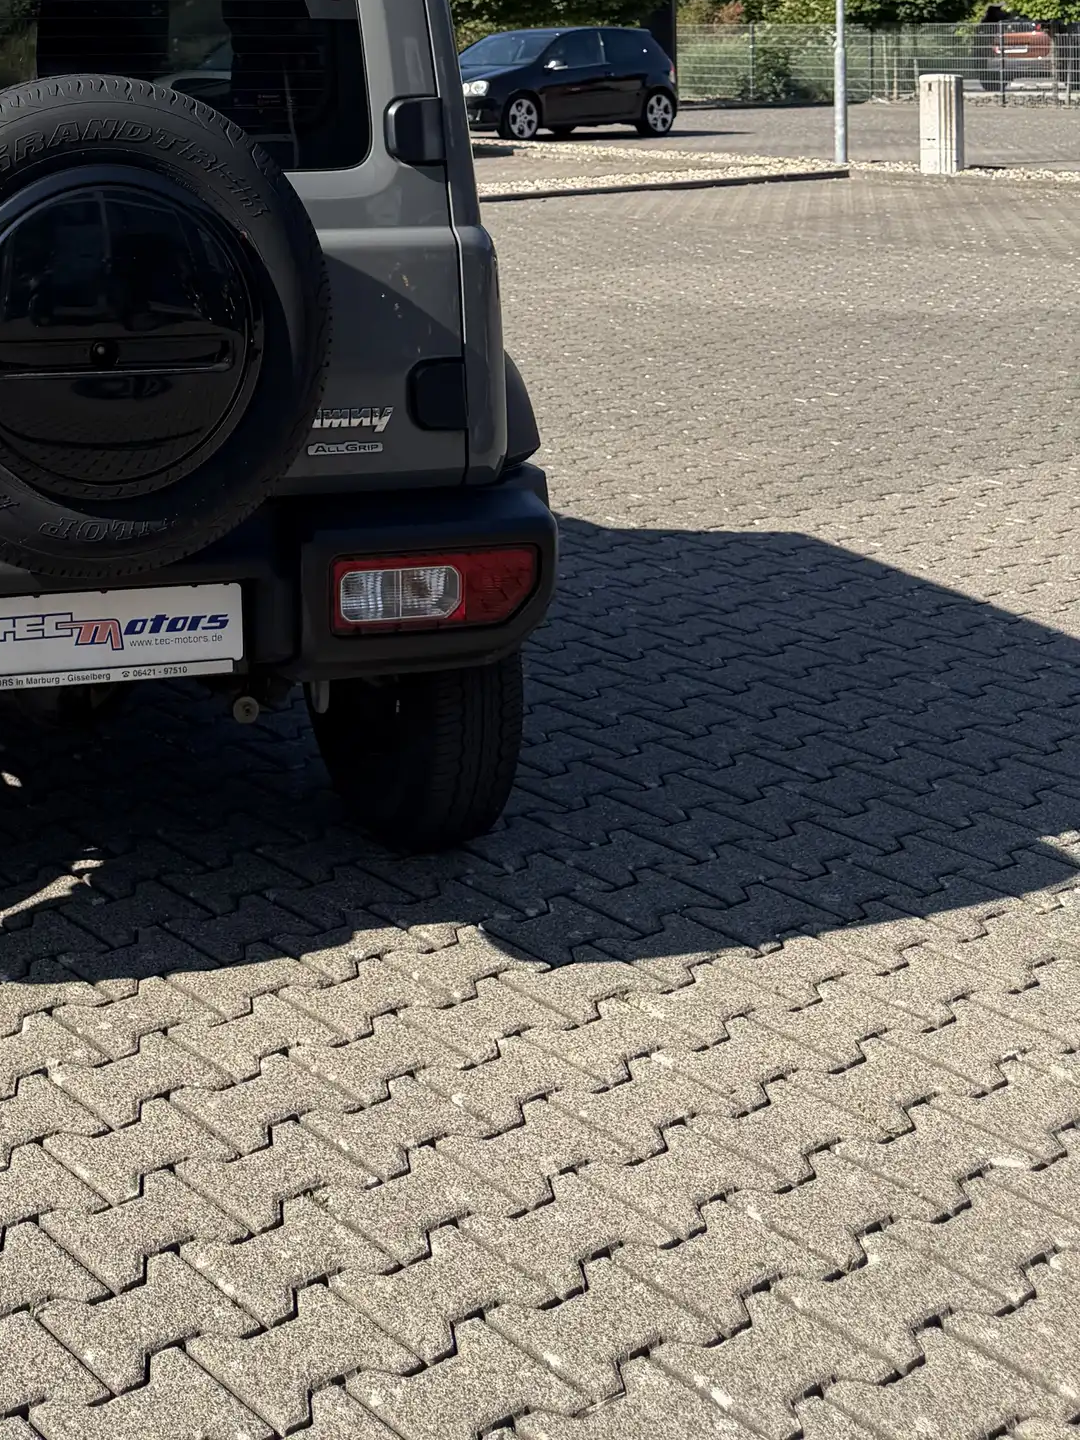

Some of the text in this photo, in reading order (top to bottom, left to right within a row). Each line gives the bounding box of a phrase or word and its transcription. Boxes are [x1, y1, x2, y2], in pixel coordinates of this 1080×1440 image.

[129, 633, 223, 648] www.tec-motors.de
[25, 675, 61, 686] Marburg
[67, 672, 111, 683] Gisselberg
[132, 668, 156, 678] 06421
